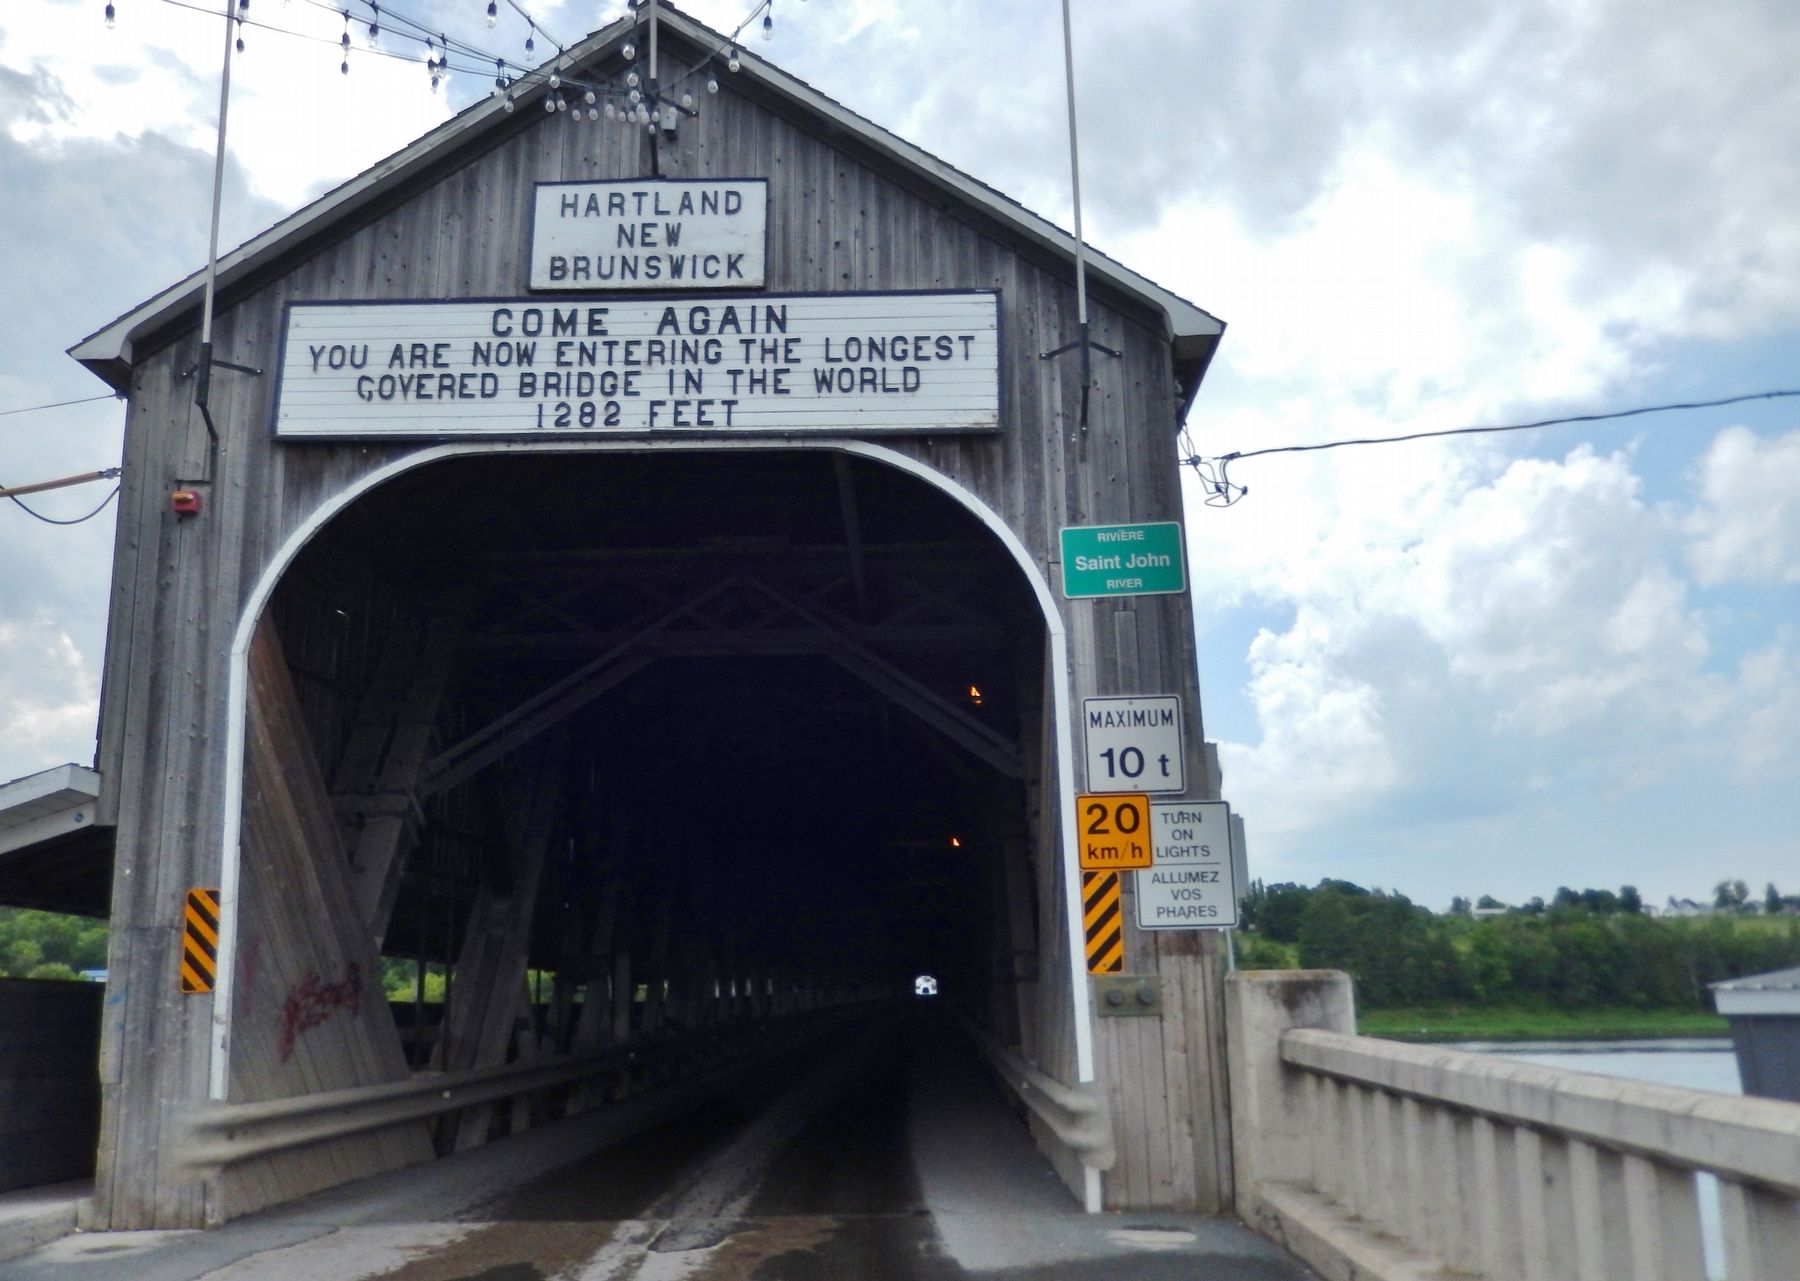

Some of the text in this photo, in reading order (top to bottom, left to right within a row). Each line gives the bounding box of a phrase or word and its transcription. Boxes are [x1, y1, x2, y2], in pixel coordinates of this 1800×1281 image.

[559, 190, 742, 218] HARTLAND
[616, 223, 682, 248] NEW
[549, 253, 746, 282] BRUNSWICK
[491, 305, 789, 336] COME AGAIN
[309, 335, 976, 373] YOU ARE NOW ENTERING THE LONGEST
[357, 367, 922, 402] COVERED BRIDGE IN THE WORLD
[536, 400, 739, 428] 1282 FEET
[1097, 529, 1145, 542] RIVIÈRE
[1075, 553, 1170, 571] Saint John
[1106, 578, 1142, 590] RIVER
[1090, 708, 1174, 729] MAXIMUM
[1100, 747, 1170, 778] 10 t
[1086, 803, 1140, 835] 20
[1161, 812, 1202, 825] TURN
[1171, 828, 1194, 841] ON
[1087, 840, 1143, 860] km/h
[1156, 845, 1211, 859] LIGHTS
[1151, 871, 1219, 884] ALLUMEZ
[1171, 888, 1202, 901] VOS
[1156, 905, 1218, 918] PHARES
